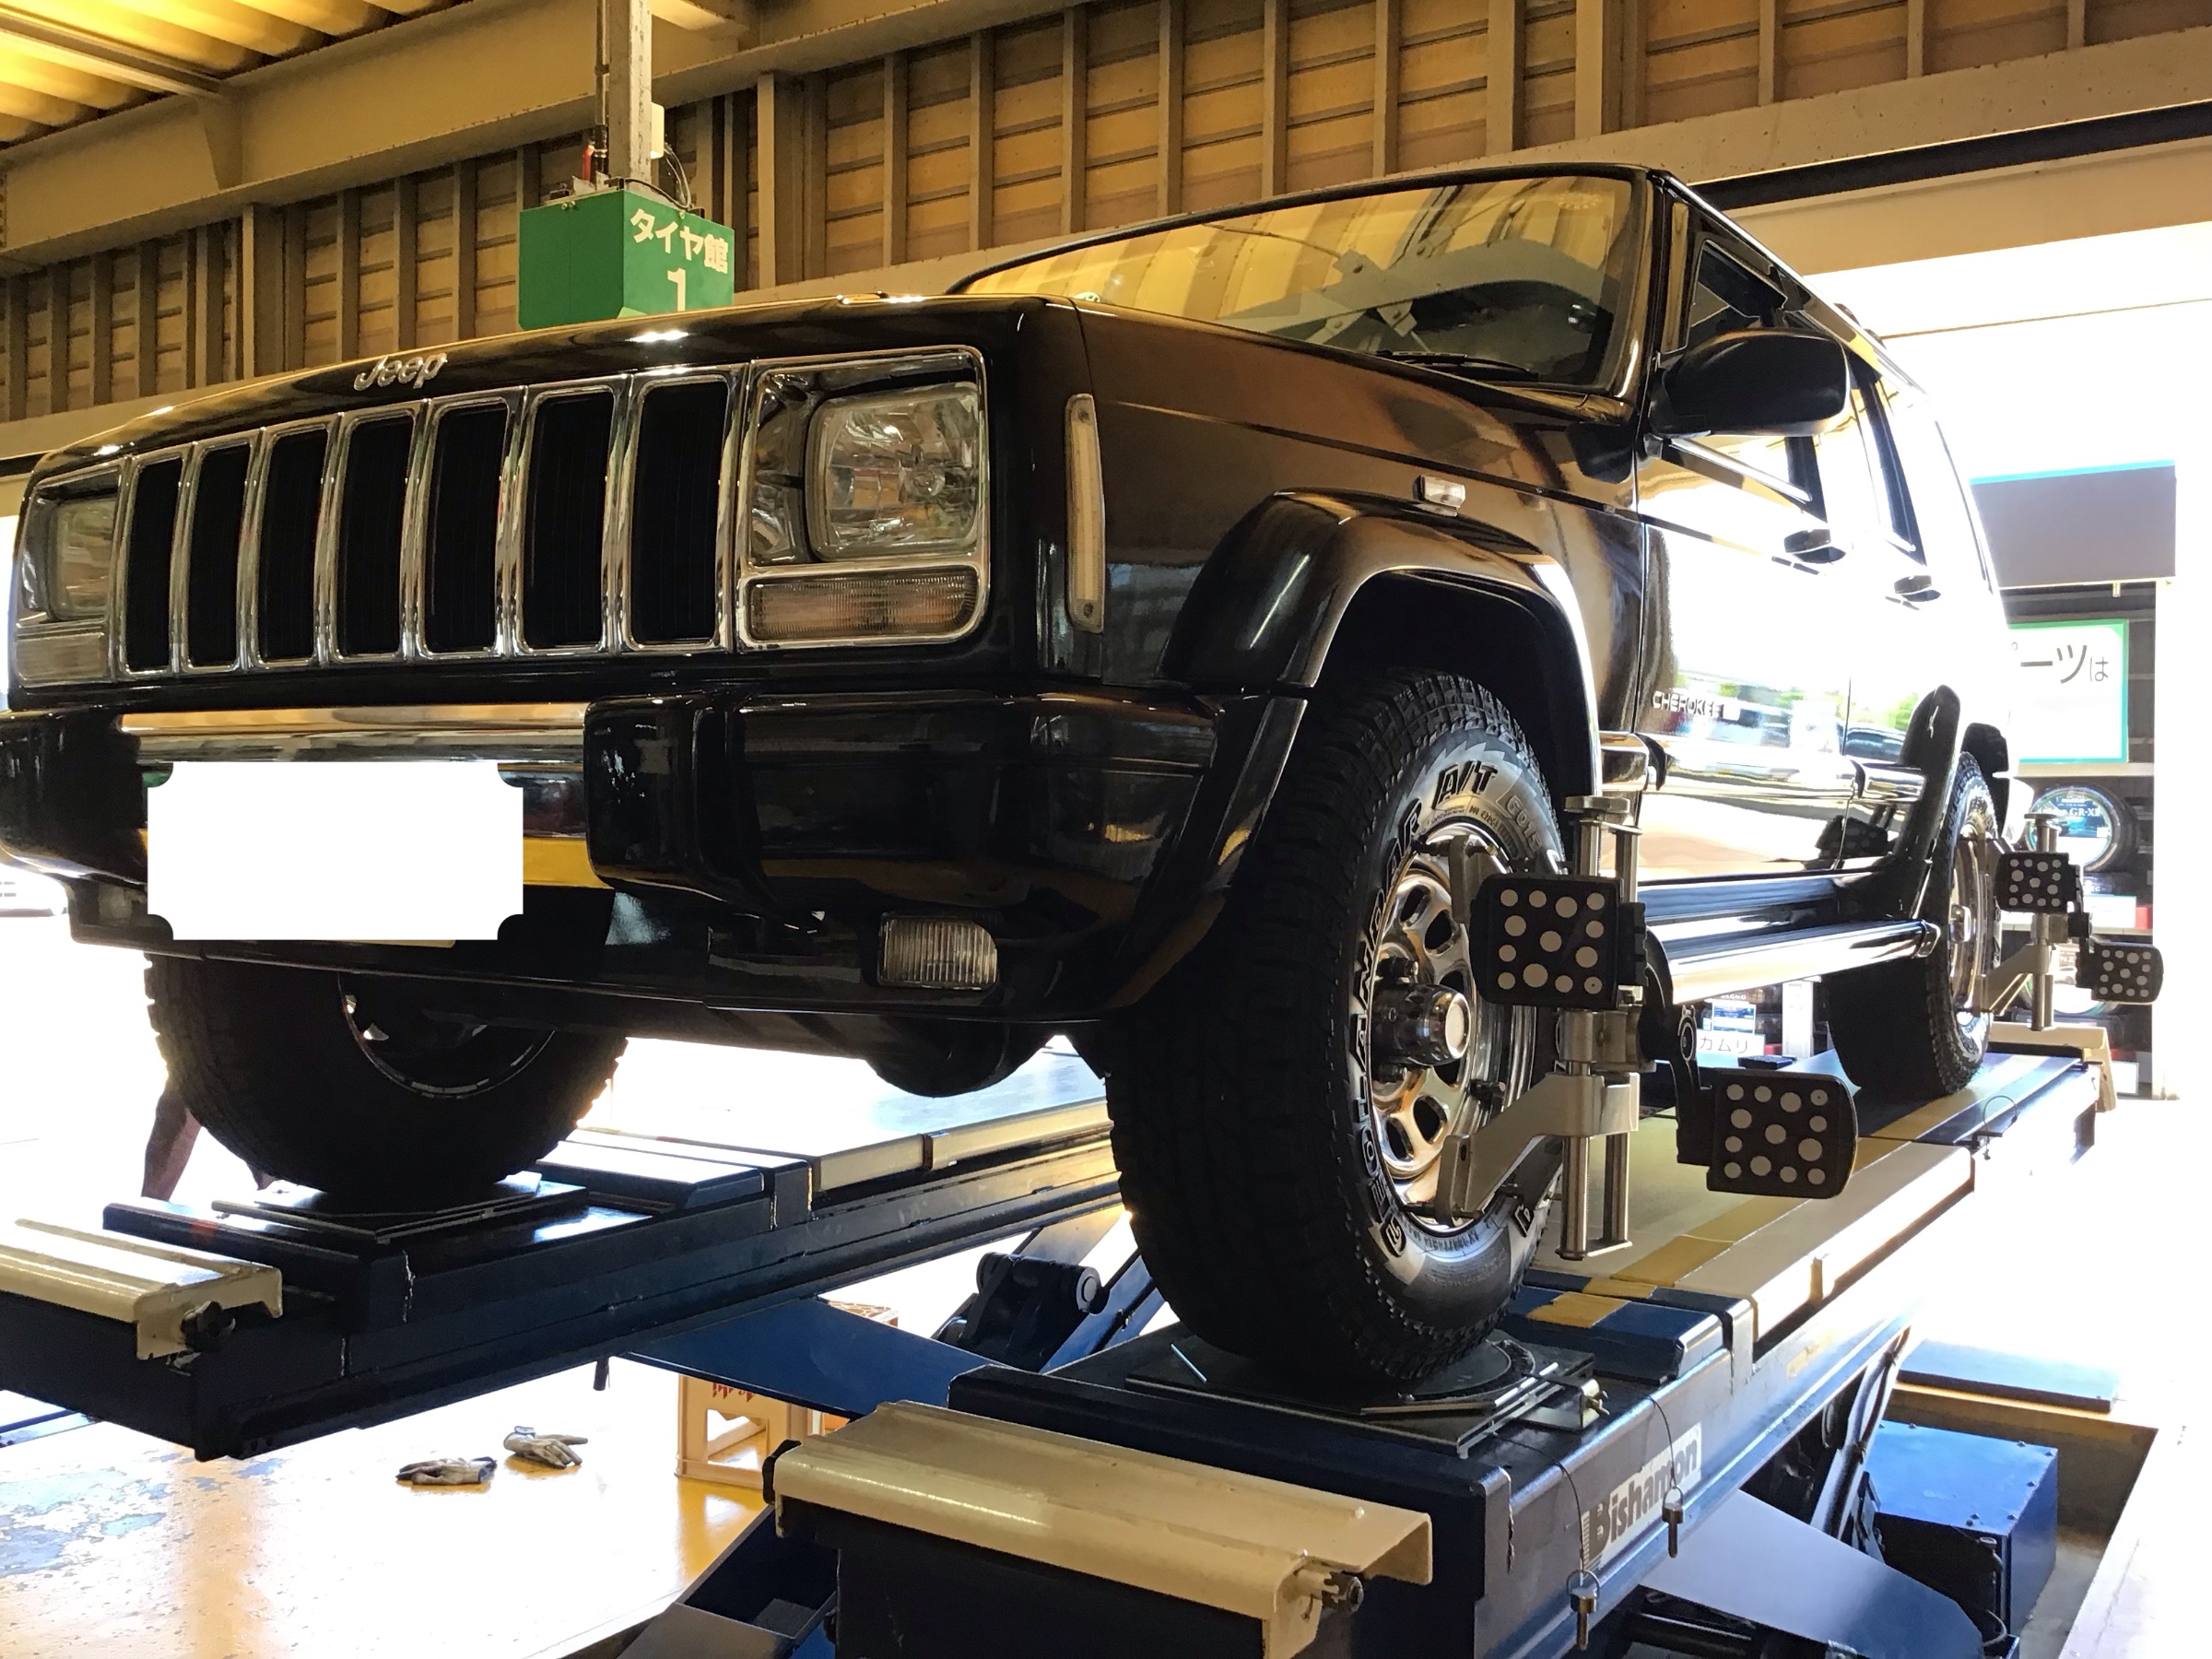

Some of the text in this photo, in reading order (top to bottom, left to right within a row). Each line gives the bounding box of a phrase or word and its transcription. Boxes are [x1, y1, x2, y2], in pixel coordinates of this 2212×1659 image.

[629, 207, 729, 275] タイヤ館
[666, 267, 687, 312] 1
[353, 352, 448, 392] Jeep
[2010, 641, 2110, 684] ーツは
[1431, 759, 1499, 810] A/T
[1700, 1035, 1748, 1054] カムリ
[1583, 1439, 1698, 1561] Bishamon
